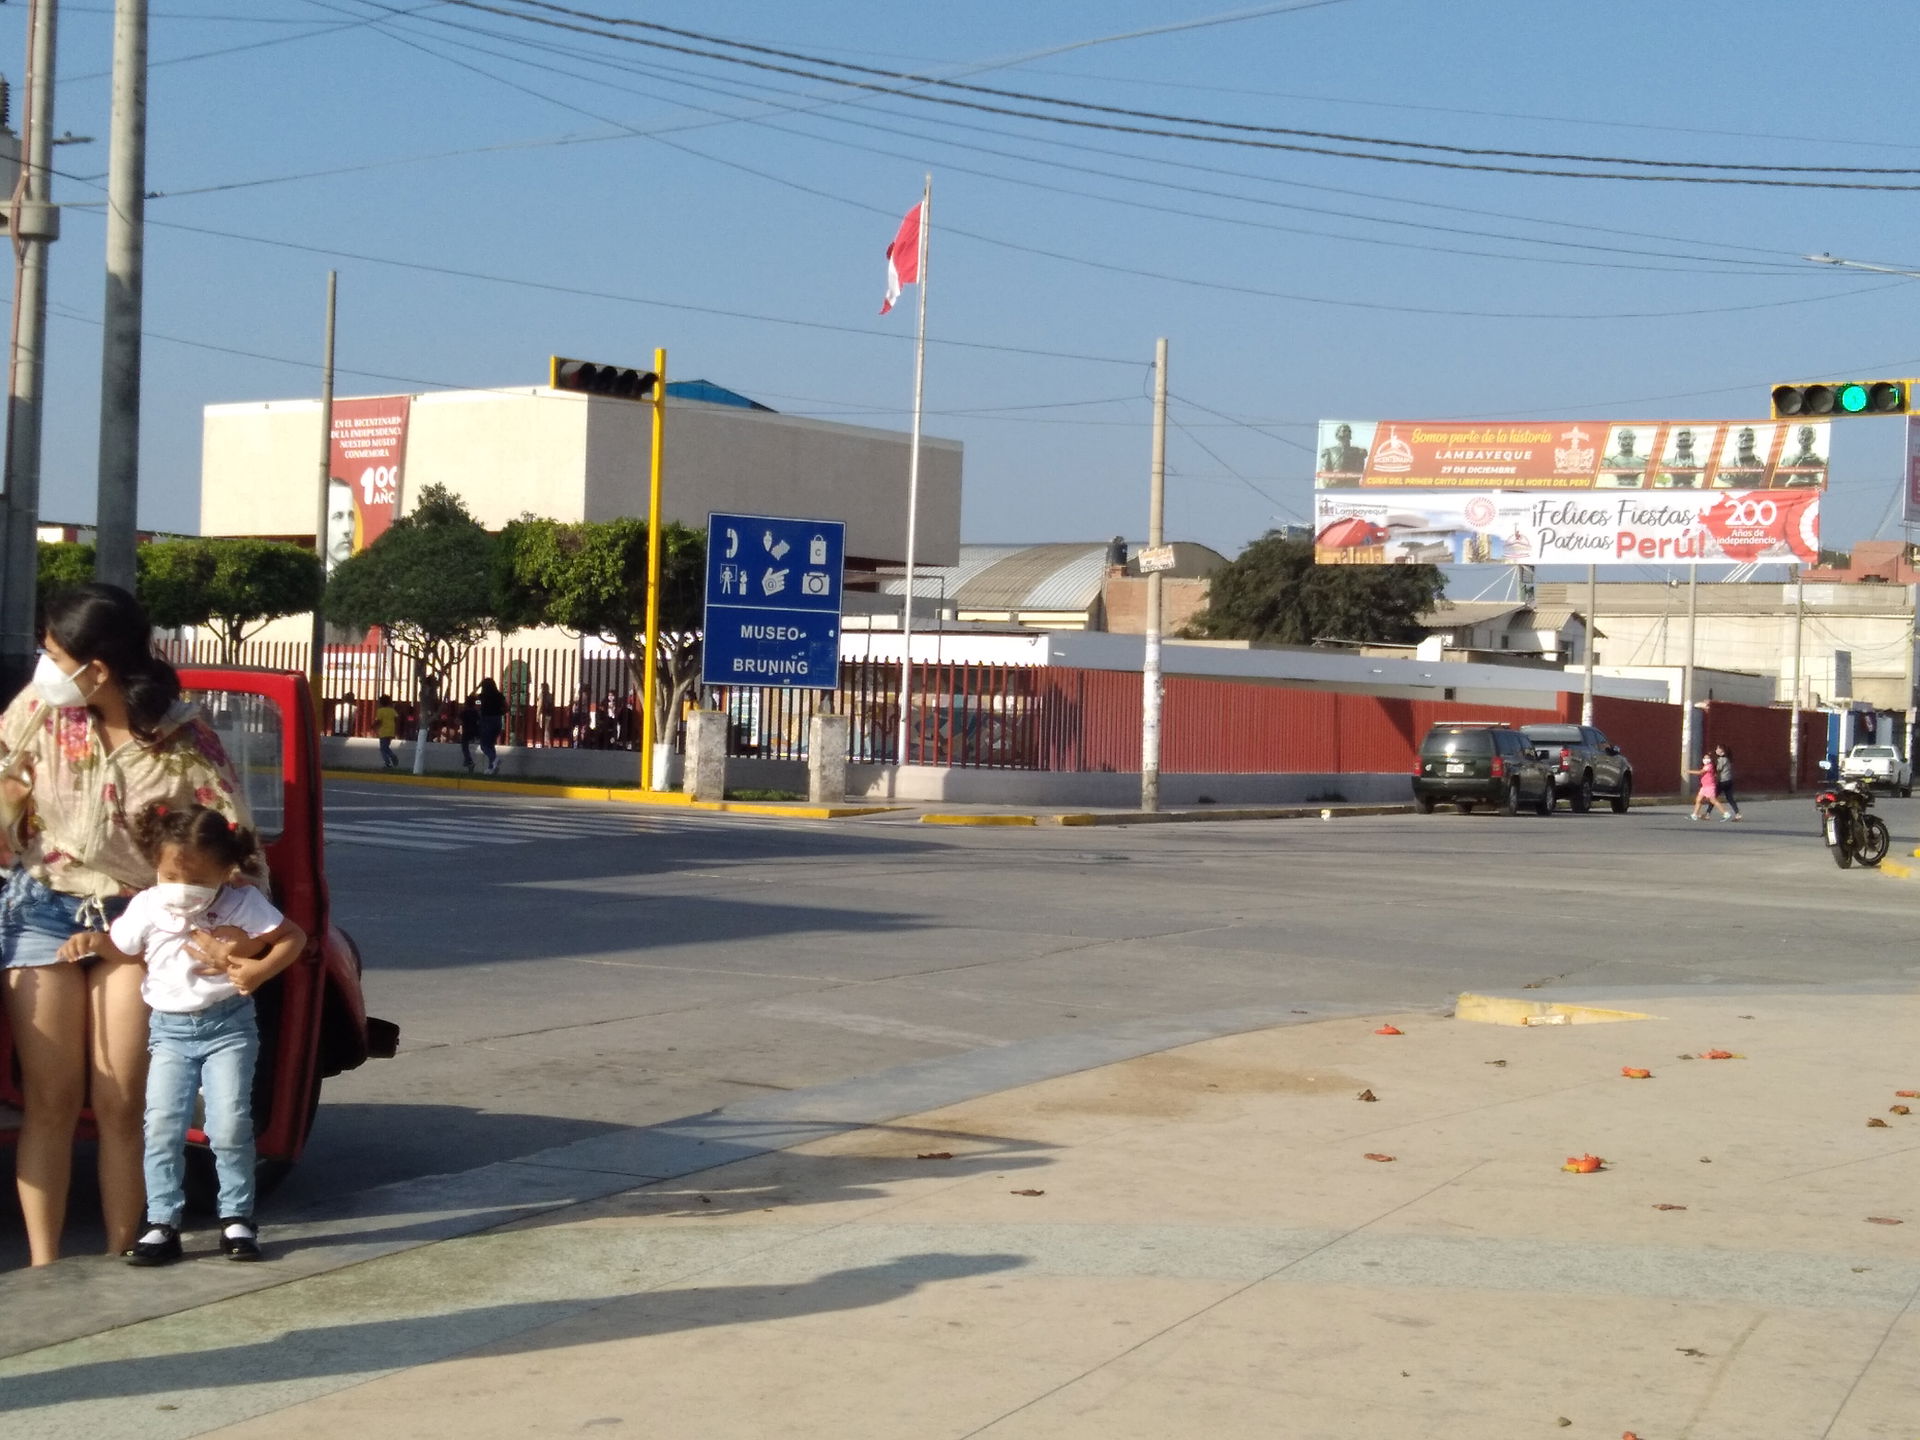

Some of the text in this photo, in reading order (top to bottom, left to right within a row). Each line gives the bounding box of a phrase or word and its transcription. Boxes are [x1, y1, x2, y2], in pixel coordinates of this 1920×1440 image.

[335, 419, 344, 428] EN
[344, 419, 352, 428] EL
[340, 430, 350, 439] LA
[350, 427, 401, 438] INDEPENDENC
[1412, 428, 1552, 447] Somos parte de la historia
[372, 438, 396, 447] MUSEO
[1435, 450, 1532, 461] LAMBAYEQUE
[1453, 466, 1466, 474] DE
[1466, 466, 1516, 474] DICIEMBRE
[1404, 477, 1432, 485] PRIMER
[1504, 478, 1514, 486] EN
[1516, 478, 1524, 486] EL
[1526, 478, 1552, 486] NORTE
[1553, 478, 1568, 486] DEL
[1335, 508, 1388, 516] Lambayeque
[1532, 500, 1696, 527] ¡Felices Fiestas
[1724, 500, 1777, 526] 200
[1731, 529, 1752, 537] Años
[1538, 527, 1706, 559] Patrias Perú!
[740, 624, 799, 640] MUSEO
[733, 658, 809, 674] BRUNING
